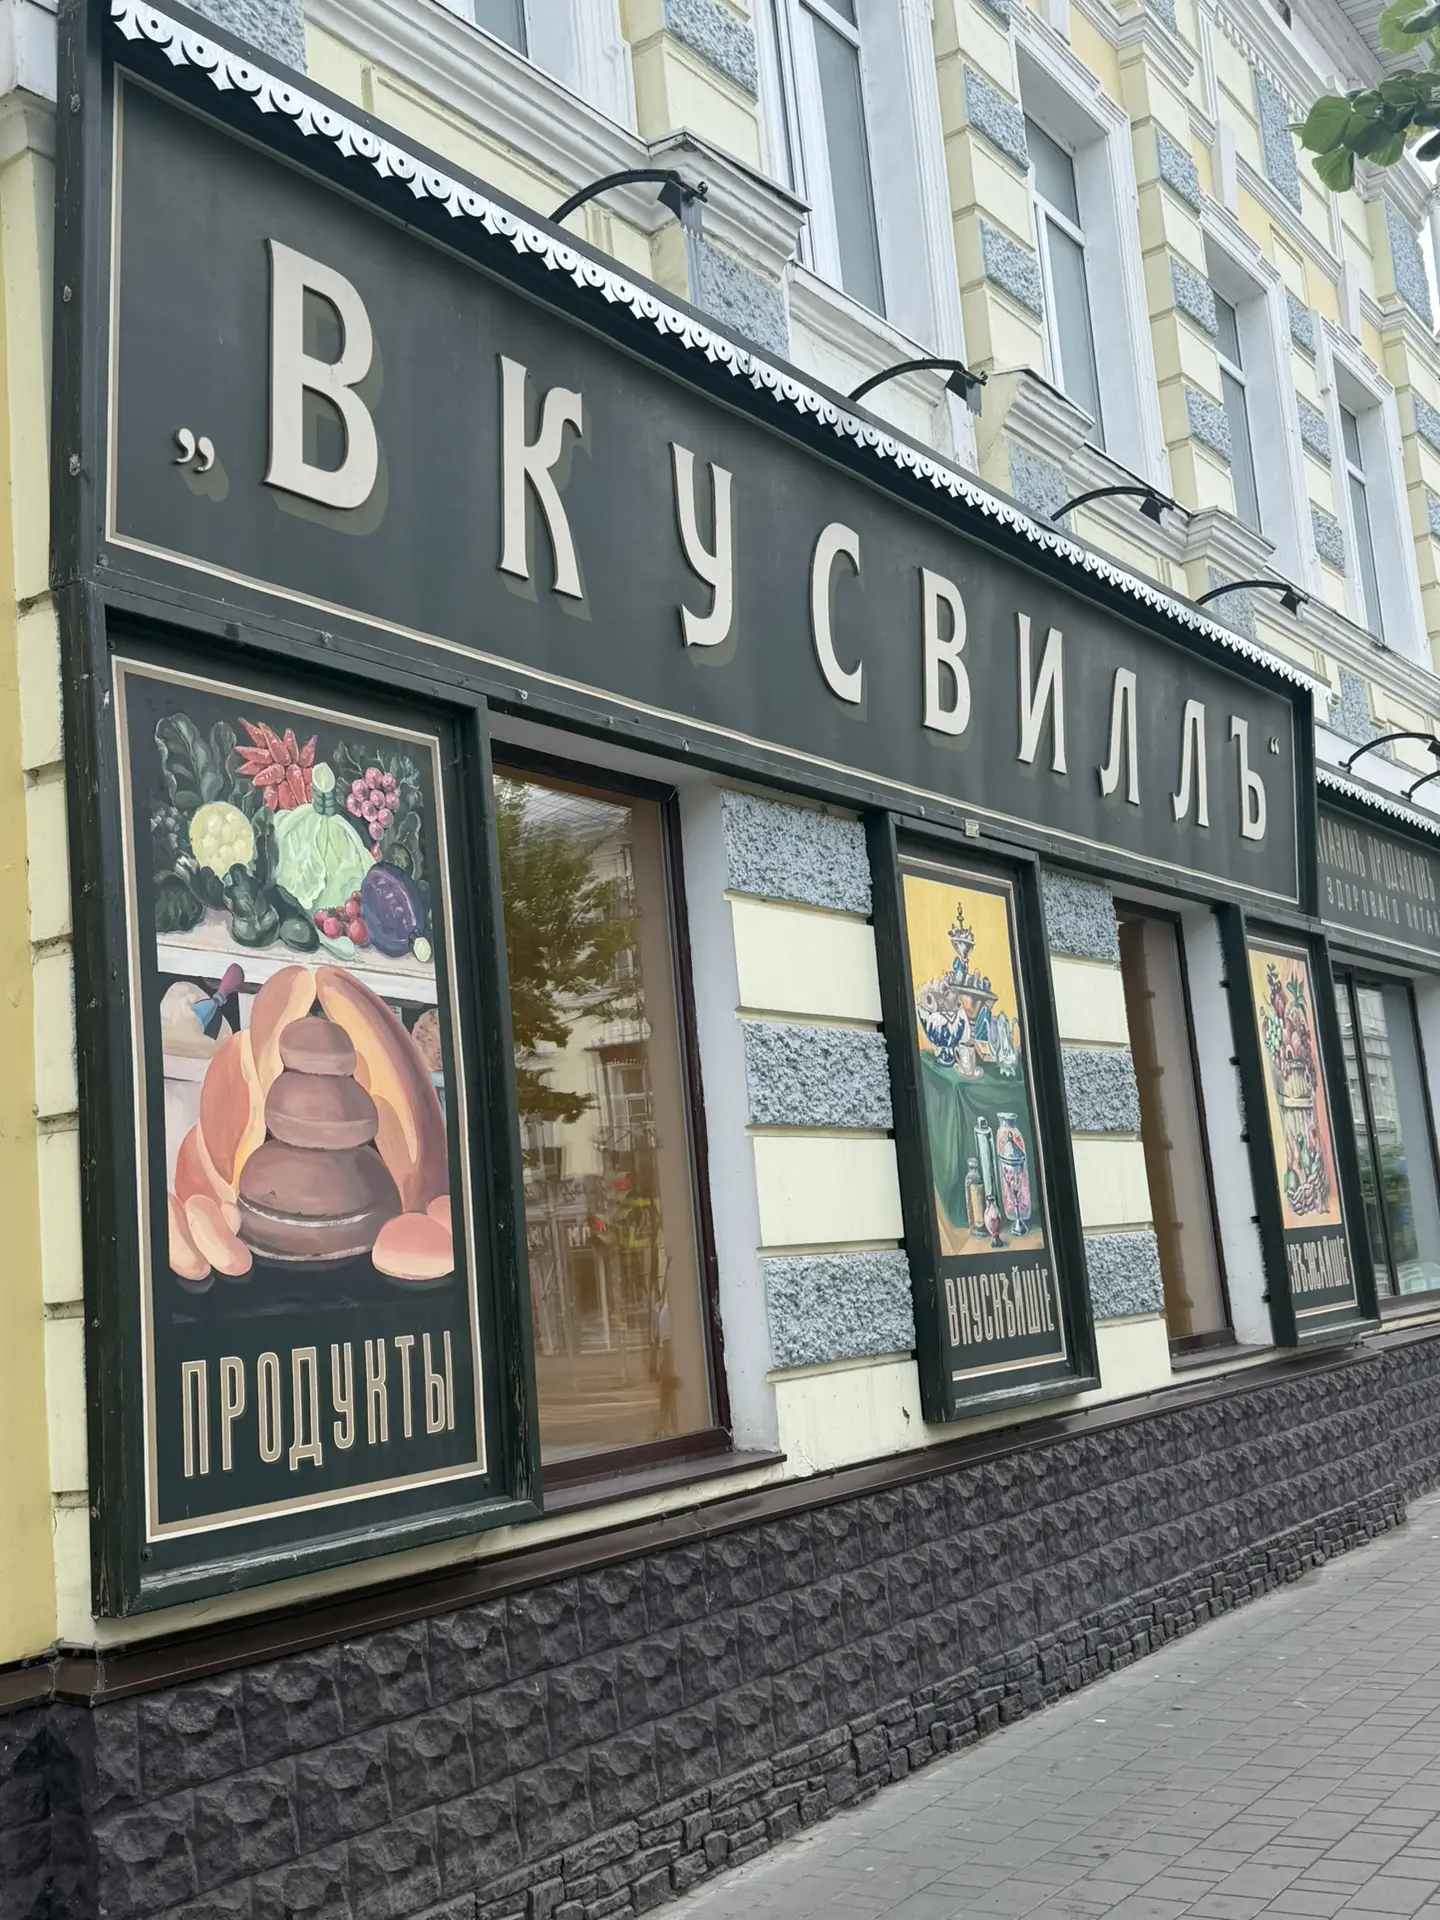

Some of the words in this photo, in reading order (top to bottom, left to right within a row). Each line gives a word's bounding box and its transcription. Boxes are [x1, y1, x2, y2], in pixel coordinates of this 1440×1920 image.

[1367, 835, 1435, 902] ПРОДУКТОВЪ
[1326, 876, 1400, 924] ЗДОРОВАГО
[1405, 902, 1440, 937] ПИТАН
[181, 1330, 455, 1478] ПРОДУКТЫ
